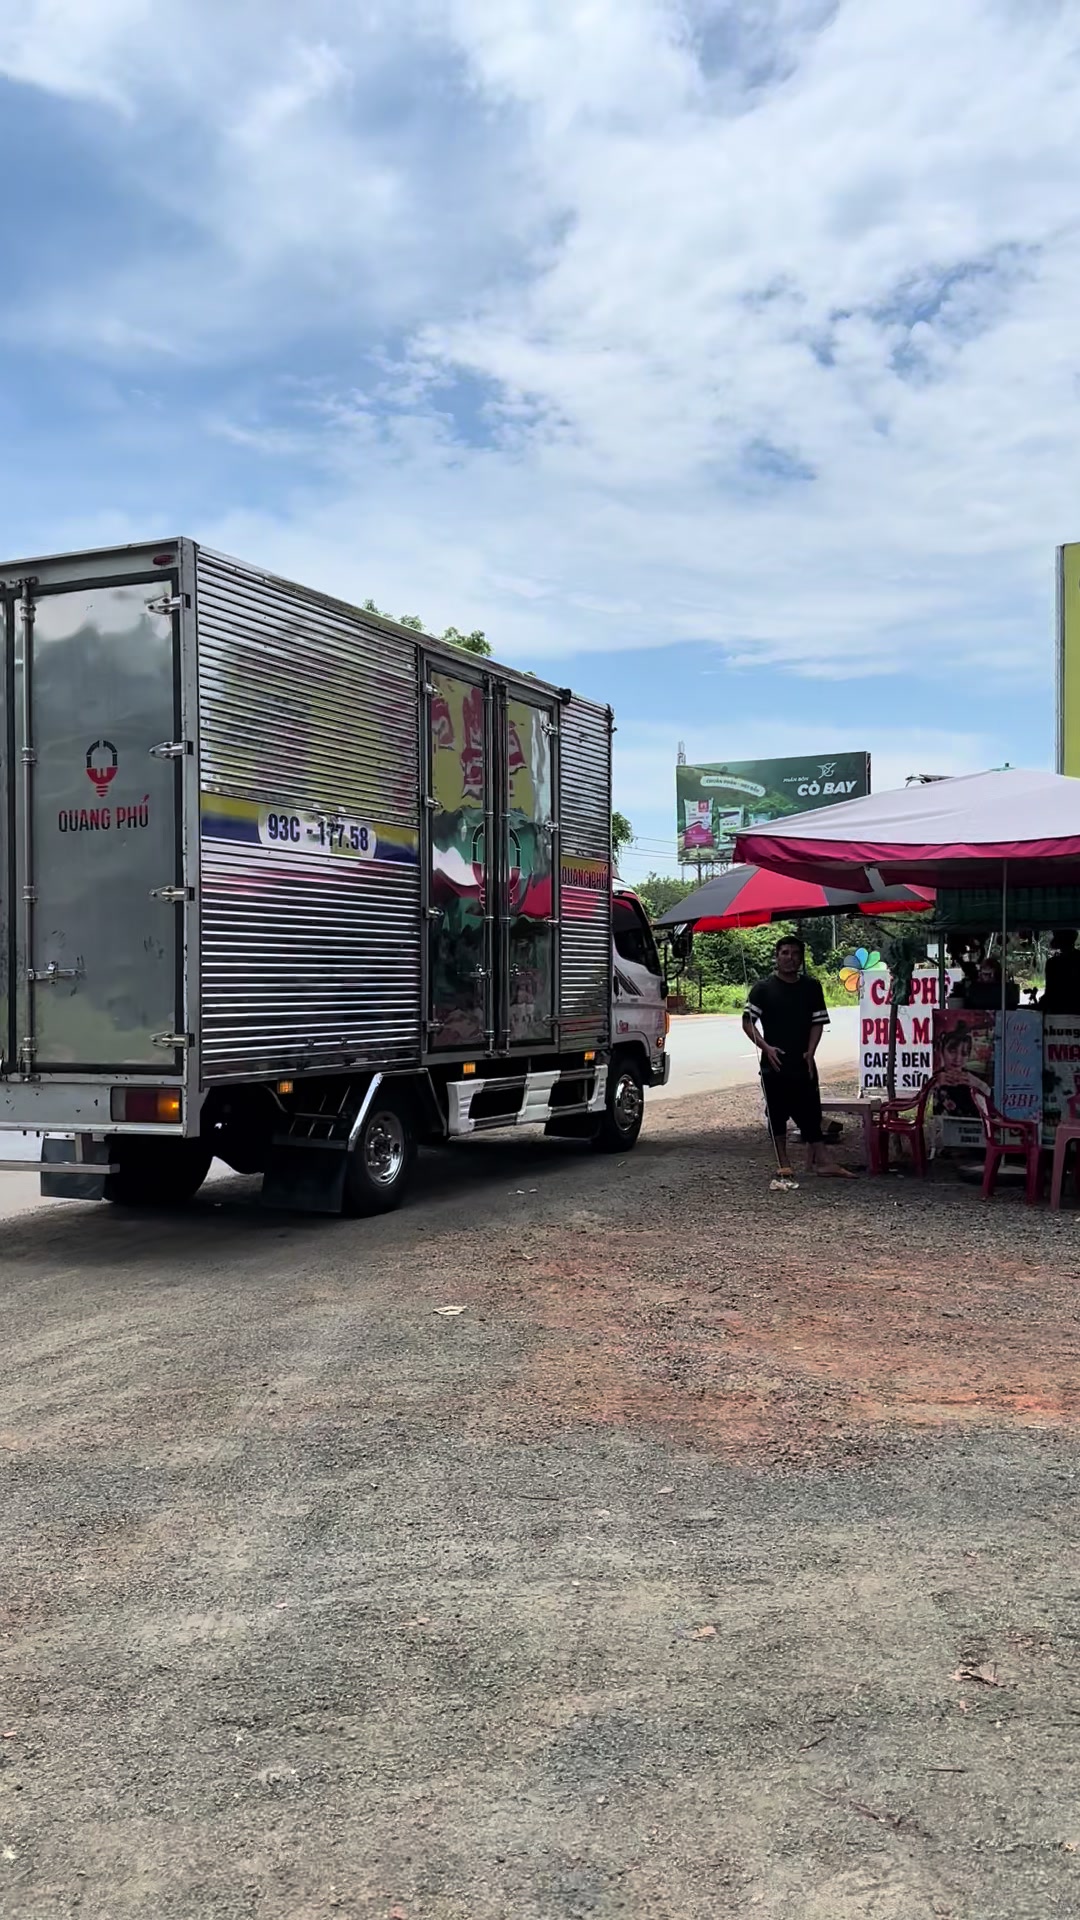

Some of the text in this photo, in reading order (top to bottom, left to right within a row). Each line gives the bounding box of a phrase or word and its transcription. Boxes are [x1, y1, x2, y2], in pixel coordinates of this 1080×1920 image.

[822, 780, 858, 795] BAY
[58, 794, 149, 832] QUANG PHÚ
[268, 813, 300, 842] 93C
[902, 1052, 930, 1068] ĐEN
